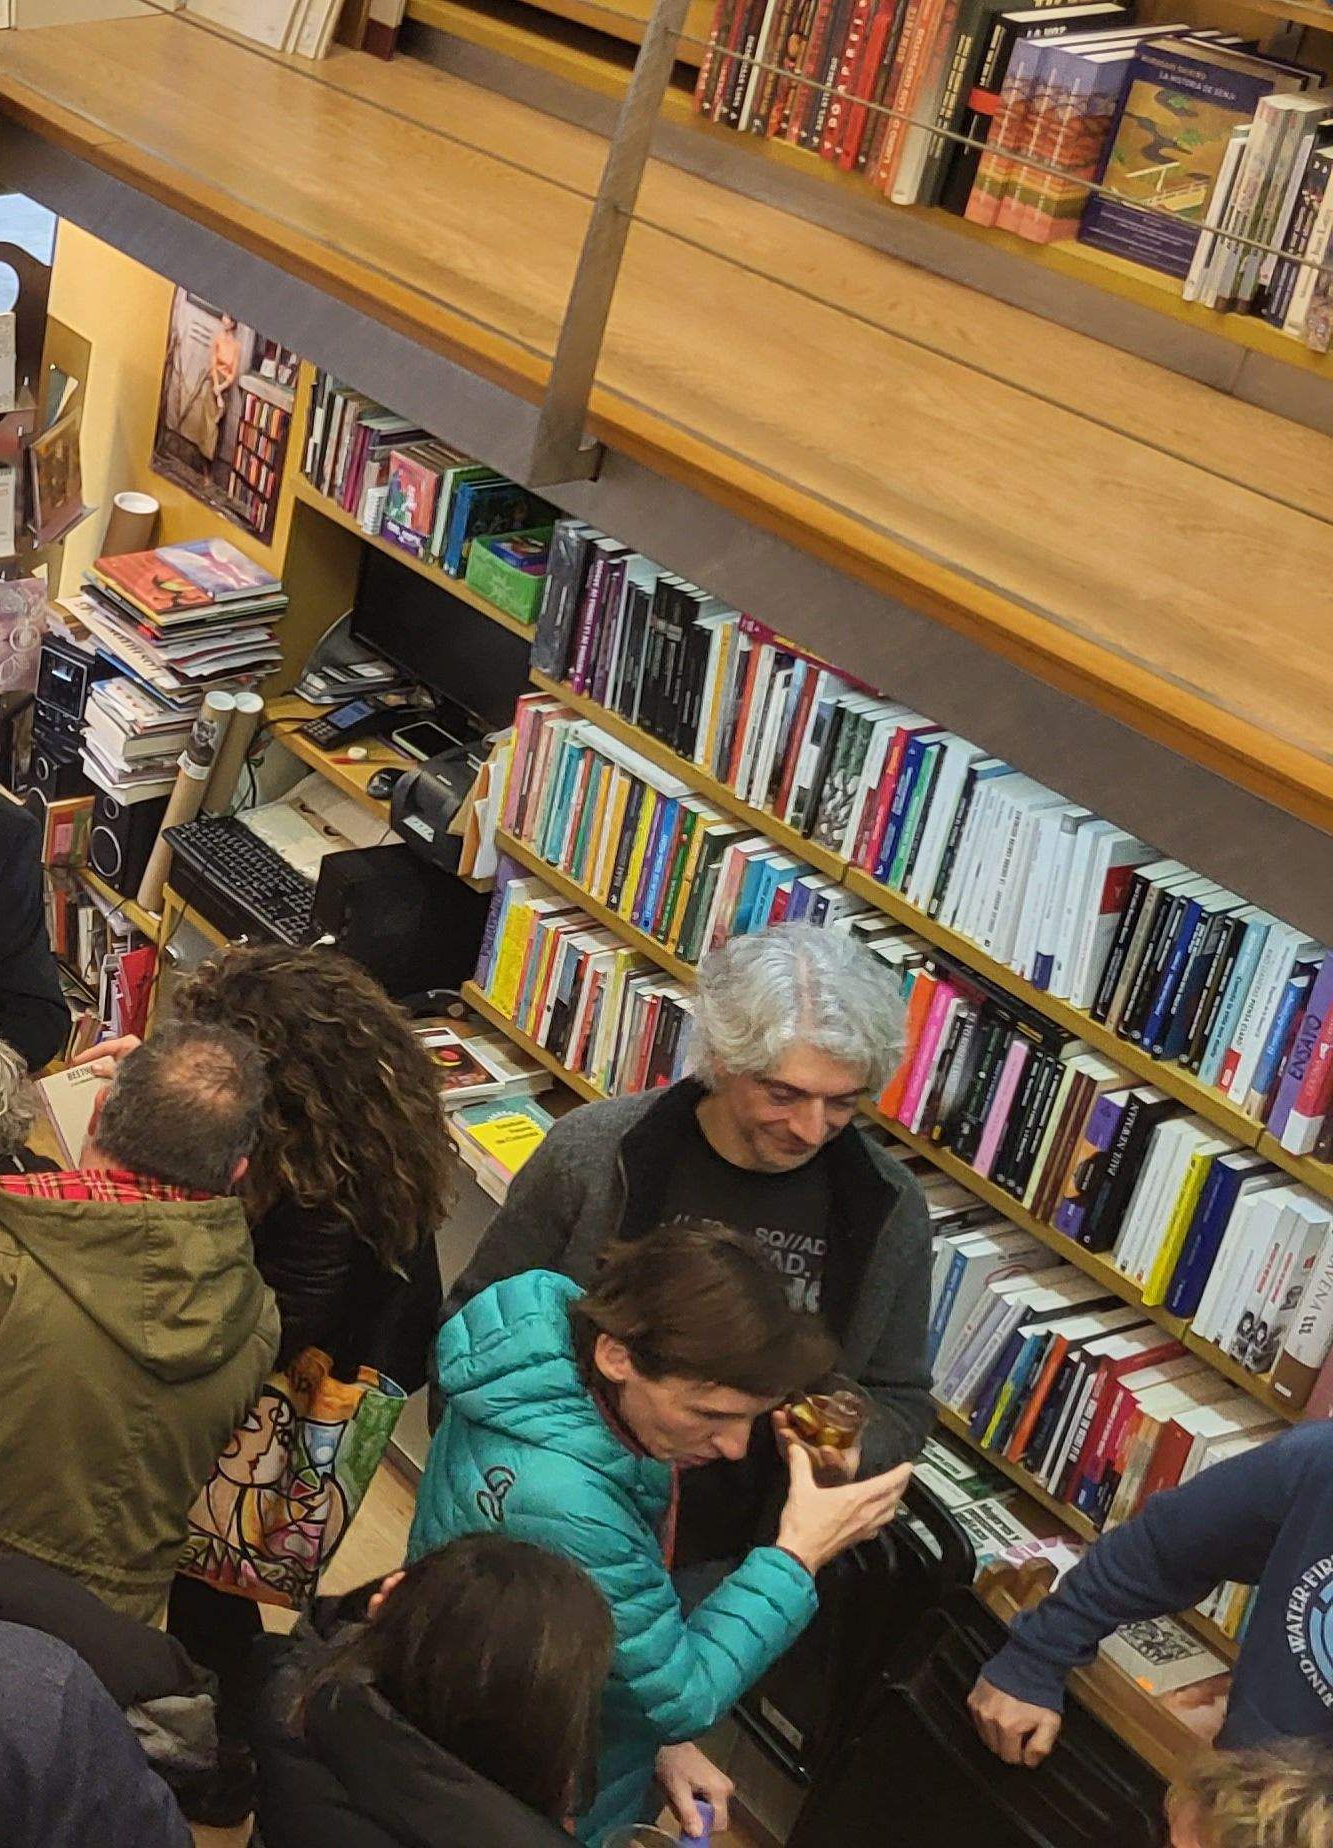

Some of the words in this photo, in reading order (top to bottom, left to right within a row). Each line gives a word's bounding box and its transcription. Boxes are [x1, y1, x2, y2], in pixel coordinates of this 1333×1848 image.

[1106, 1151, 1122, 1176] PAUL
[1116, 1102, 1140, 1150] NEWMAN
[1286, 1586, 1311, 1653] WATER
